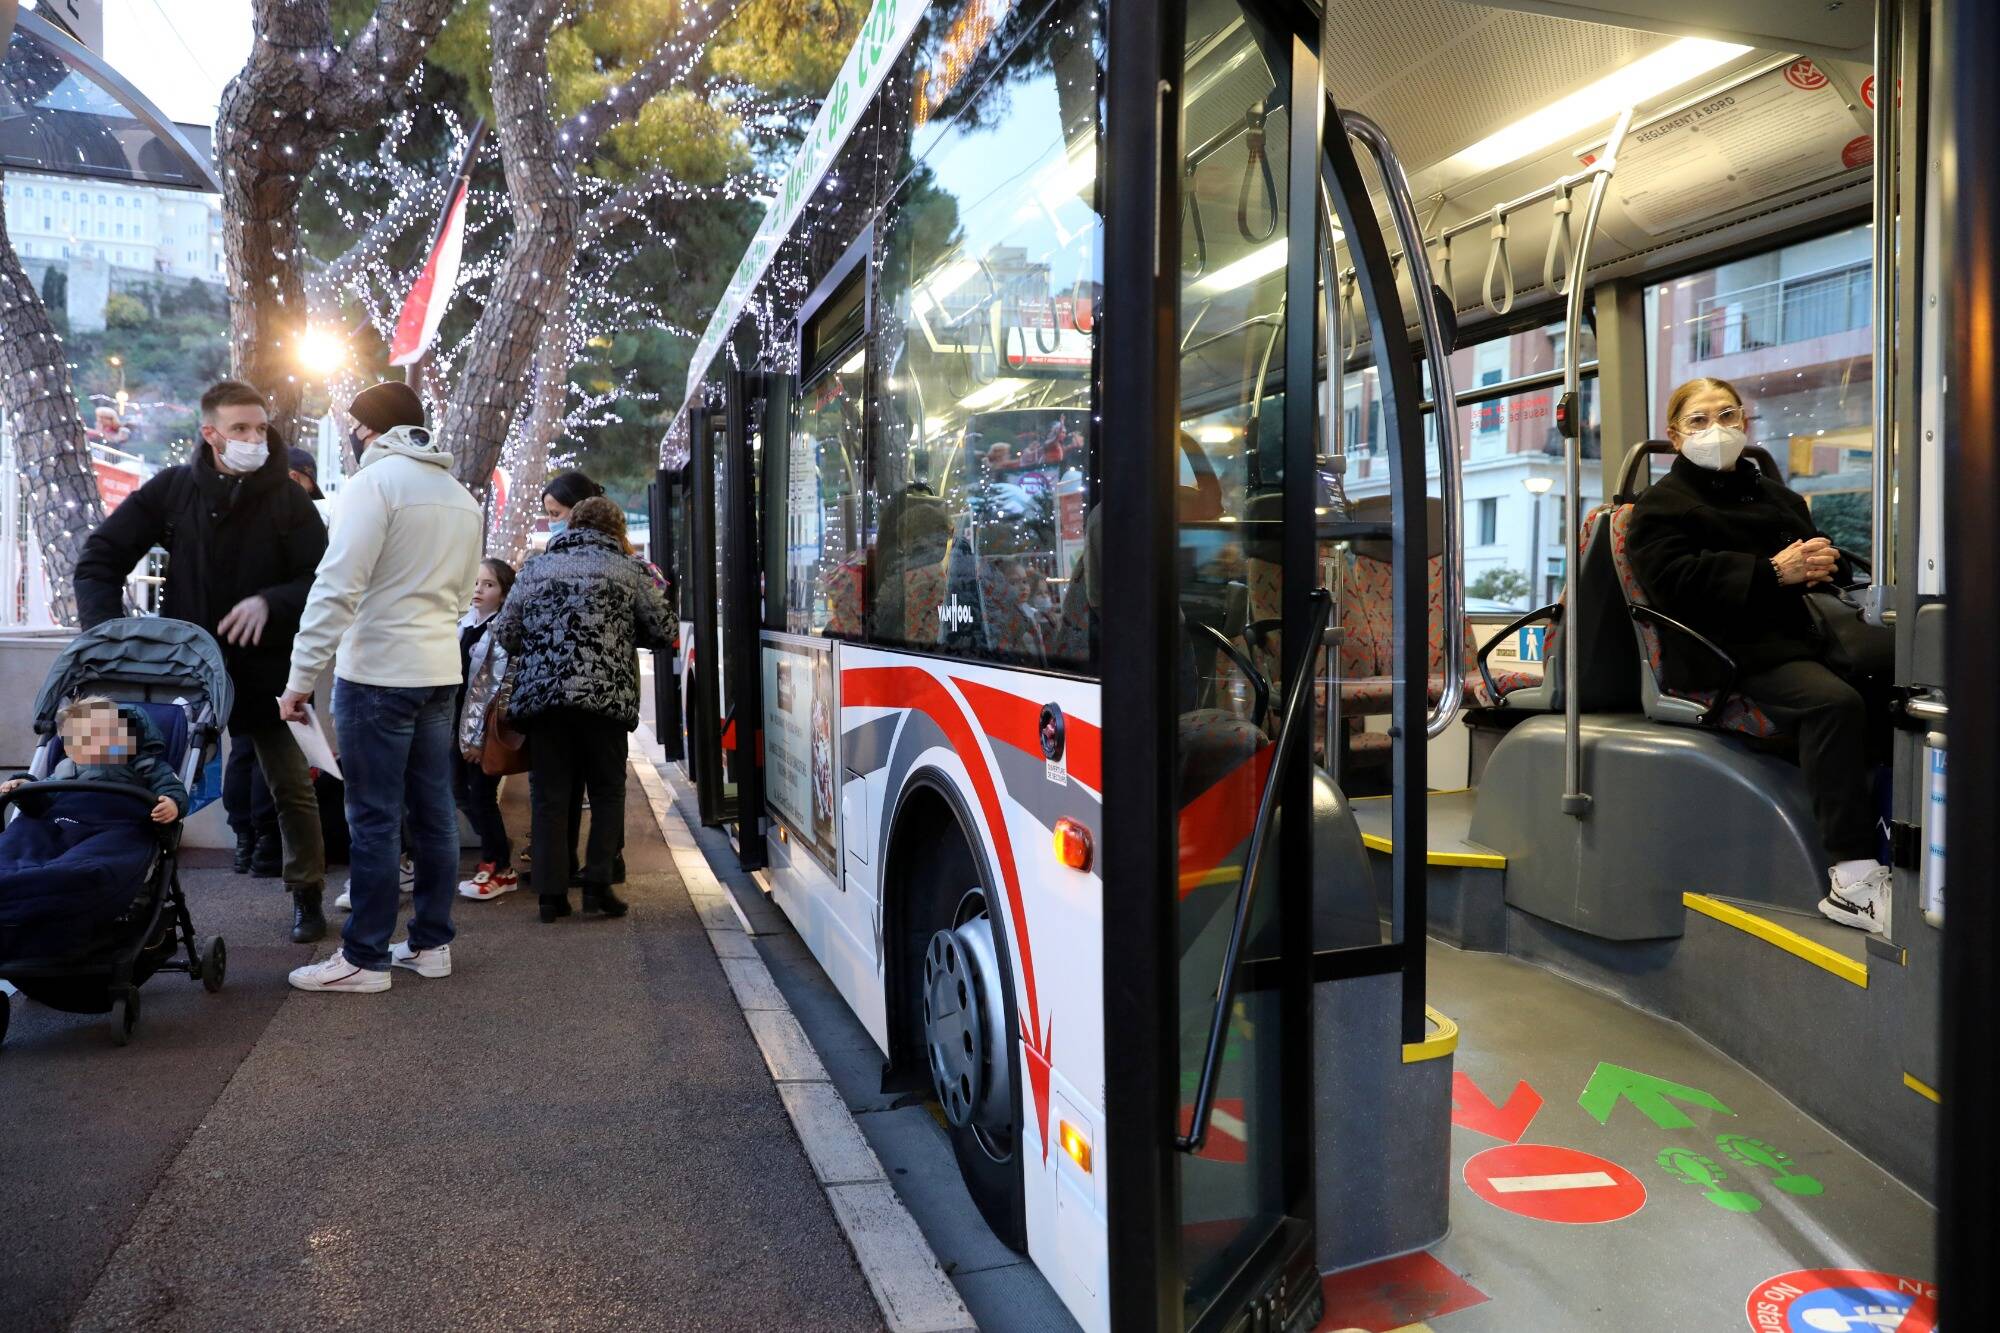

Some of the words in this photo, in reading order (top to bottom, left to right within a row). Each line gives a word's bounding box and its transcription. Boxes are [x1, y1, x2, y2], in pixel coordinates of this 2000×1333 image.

[828, 79, 849, 143] de
[1702, 96, 1736, 115] BORD
[1763, 1281, 1804, 1302] No
